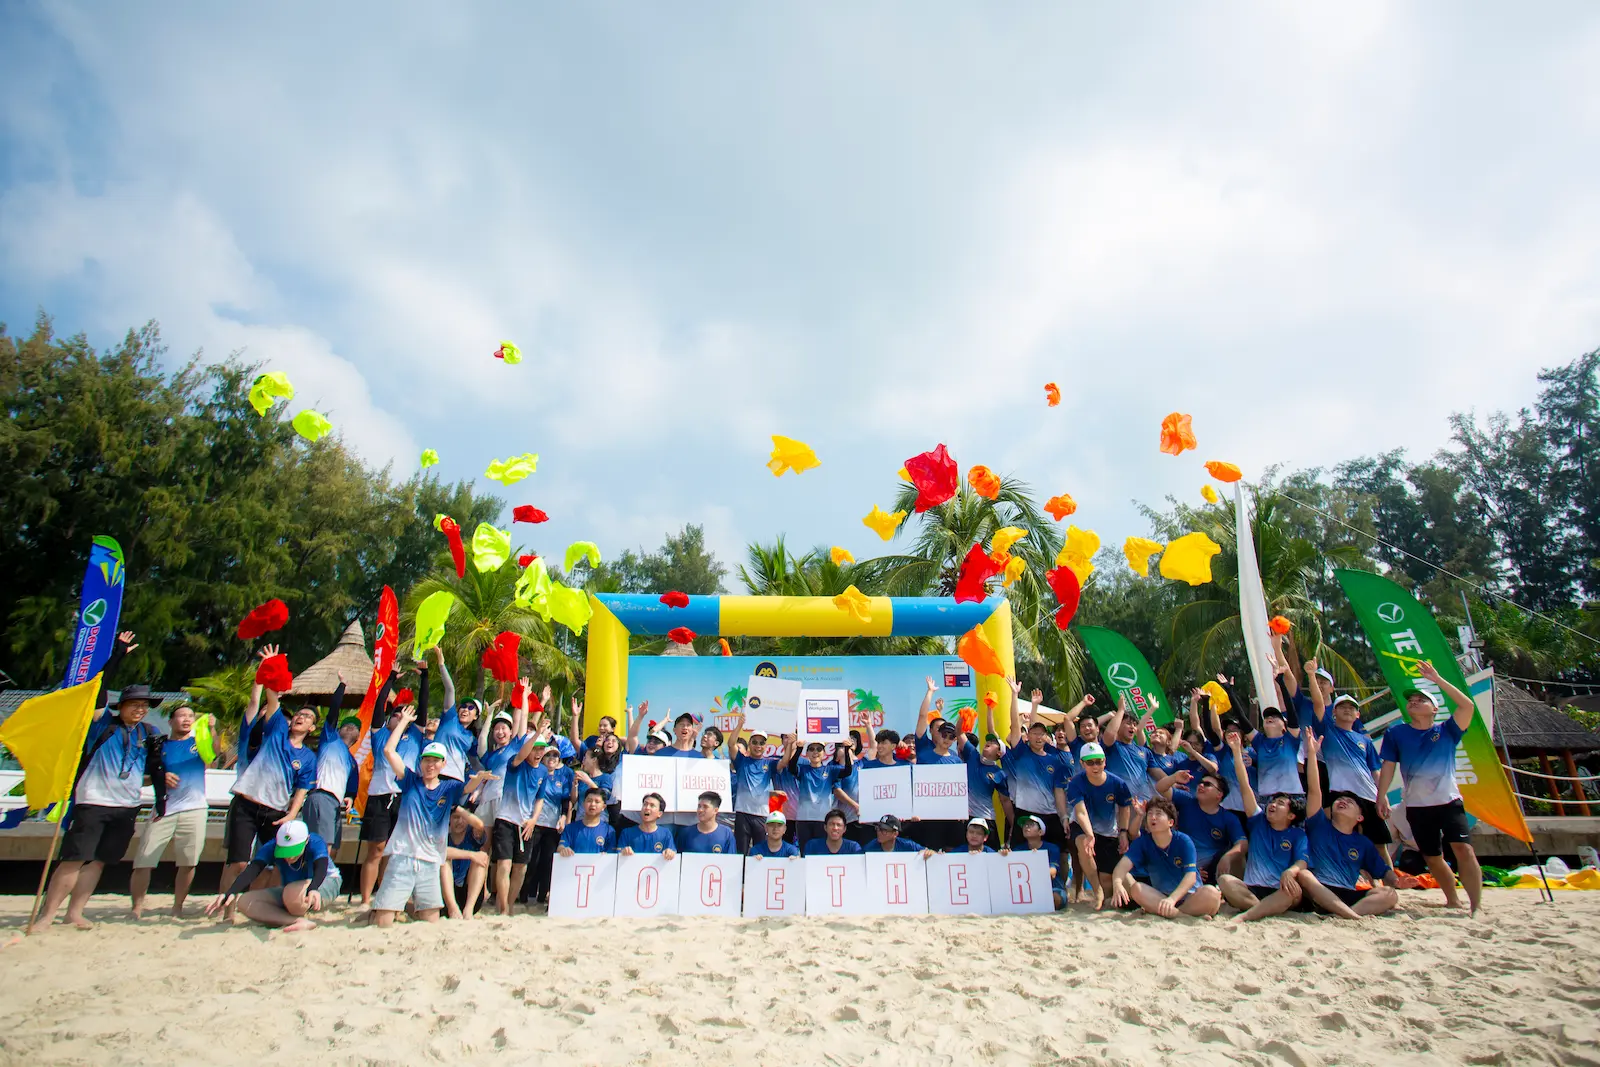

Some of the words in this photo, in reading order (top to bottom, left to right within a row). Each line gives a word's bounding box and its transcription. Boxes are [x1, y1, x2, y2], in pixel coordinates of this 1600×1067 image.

[85, 626, 101, 652] DAT
[1129, 686, 1150, 711] DAT
[638, 773, 664, 789] NEW
[682, 774, 726, 790] HEIGHTS
[873, 783, 897, 799] NEW
[914, 782, 967, 797] HORIZONS
